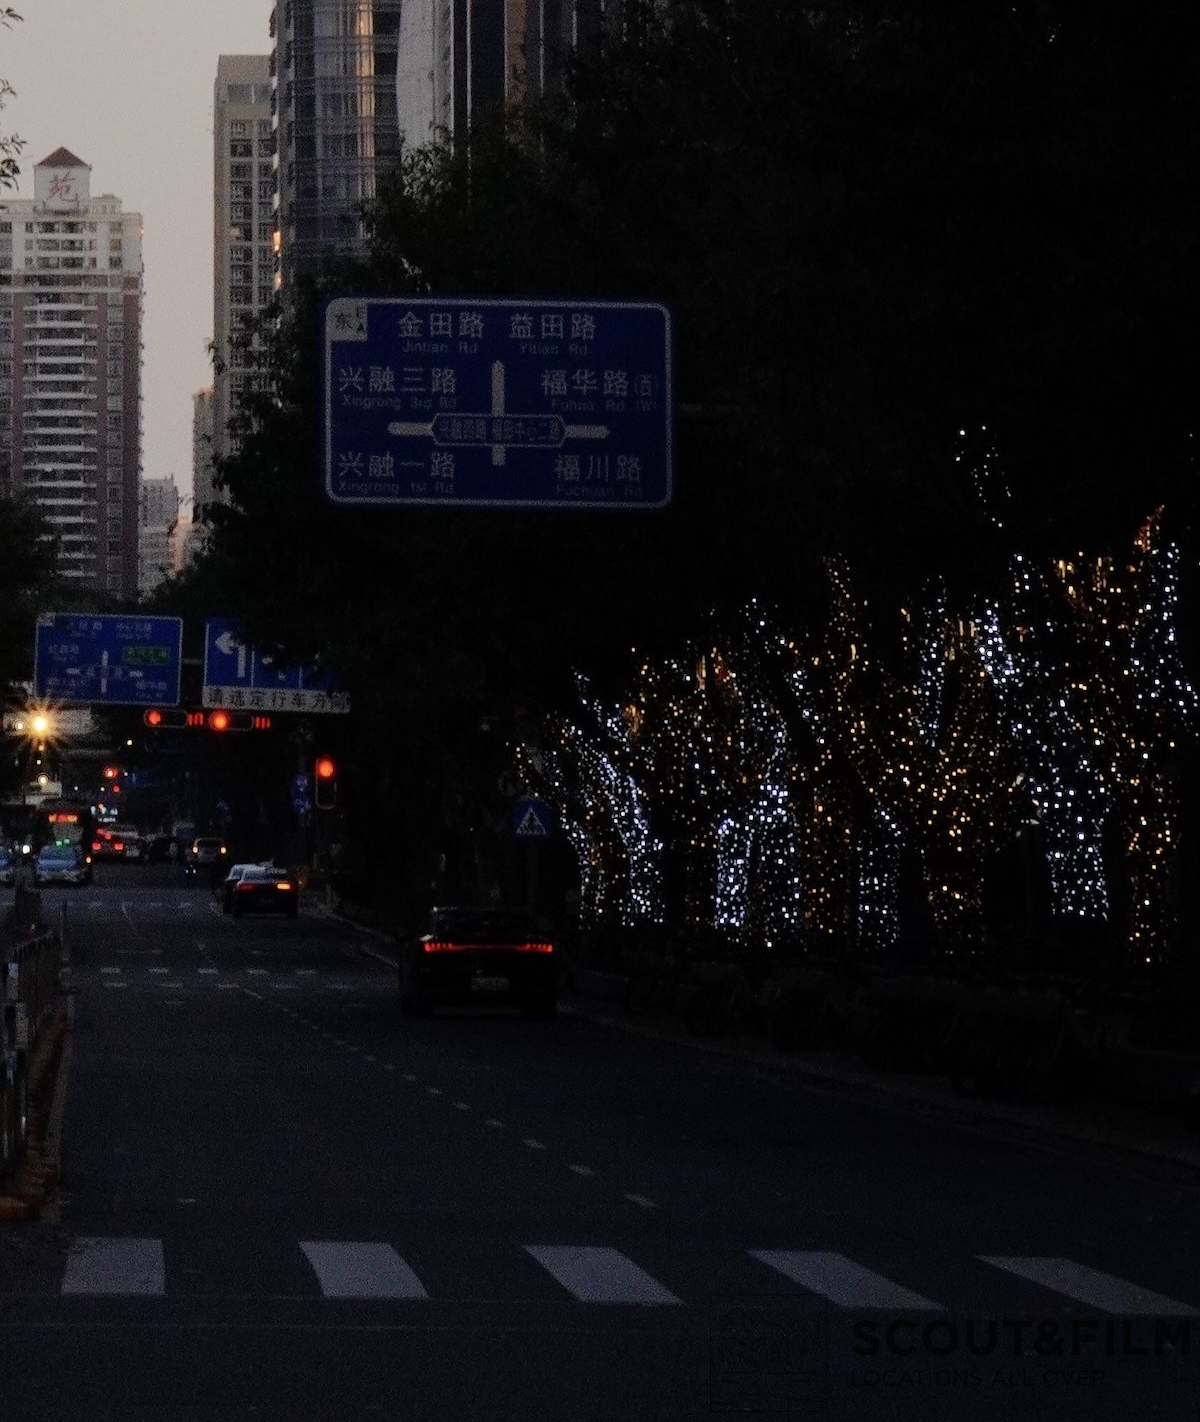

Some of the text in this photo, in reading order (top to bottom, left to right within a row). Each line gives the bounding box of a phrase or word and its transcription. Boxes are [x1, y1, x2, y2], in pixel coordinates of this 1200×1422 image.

[334, 312, 352, 329] 东
[398, 311, 597, 341] 金田路 益田路
[458, 342, 478, 354] Rd
[568, 343, 588, 355] Rd
[338, 366, 457, 394] 兴融三路
[338, 450, 456, 479] 兴融一路
[554, 454, 643, 483] 福川路
